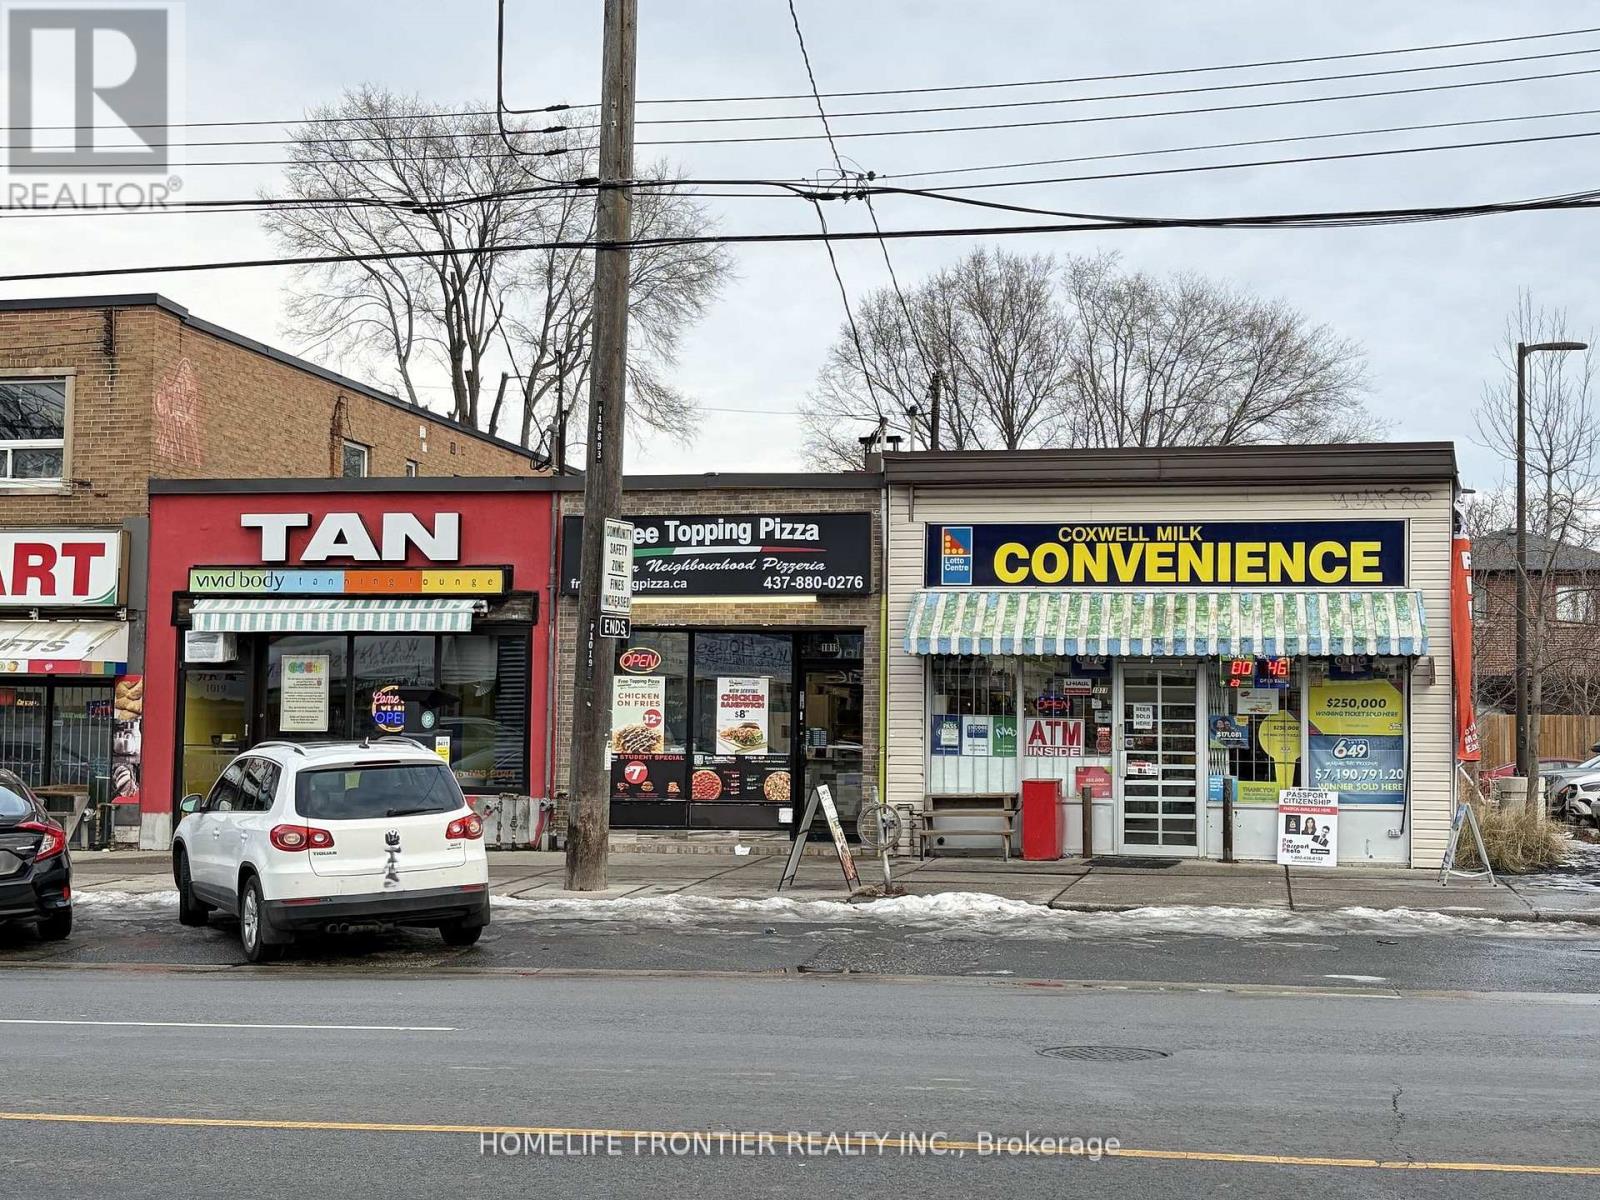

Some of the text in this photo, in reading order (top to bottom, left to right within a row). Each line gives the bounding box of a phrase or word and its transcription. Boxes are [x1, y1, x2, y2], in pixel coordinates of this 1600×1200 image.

[240, 512, 459, 561] TAN
[606, 525, 632, 540] COMMUNITY
[633, 517, 820, 546] ee Topping Pizza
[1058, 526, 1203, 542] COXWELL MILK
[609, 542, 628, 556] SAFETY
[611, 559, 625, 573] ZONE
[646, 558, 757, 575] Neighbourhood
[762, 557, 827, 574] Pizzeria
[944, 563, 969, 572] Centre
[945, 557, 964, 565] Lotto
[993, 540, 1383, 584] CONVENIENCE
[0, 542, 106, 596] RT
[239, 571, 285, 591] body
[610, 578, 625, 591] FINES
[763, 575, 864, 590] 437-880-0276
[603, 594, 630, 608] INCREASED
[604, 619, 626, 635] ENDS
[622, 654, 658, 667] OPEN
[373, 692, 400, 705] Come
[1326, 698, 1387, 709] $250,000
[375, 711, 405, 724] OPE
[1027, 720, 1081, 746] ATM
[1028, 746, 1081, 757] INSIDE
[1315, 768, 1404, 781] $7,190,791.20
[1318, 782, 1404, 791] WINNER SOLD HERE
[1283, 797, 1332, 806] CITIZENSHIP
[1286, 791, 1329, 800] PASSPORT
